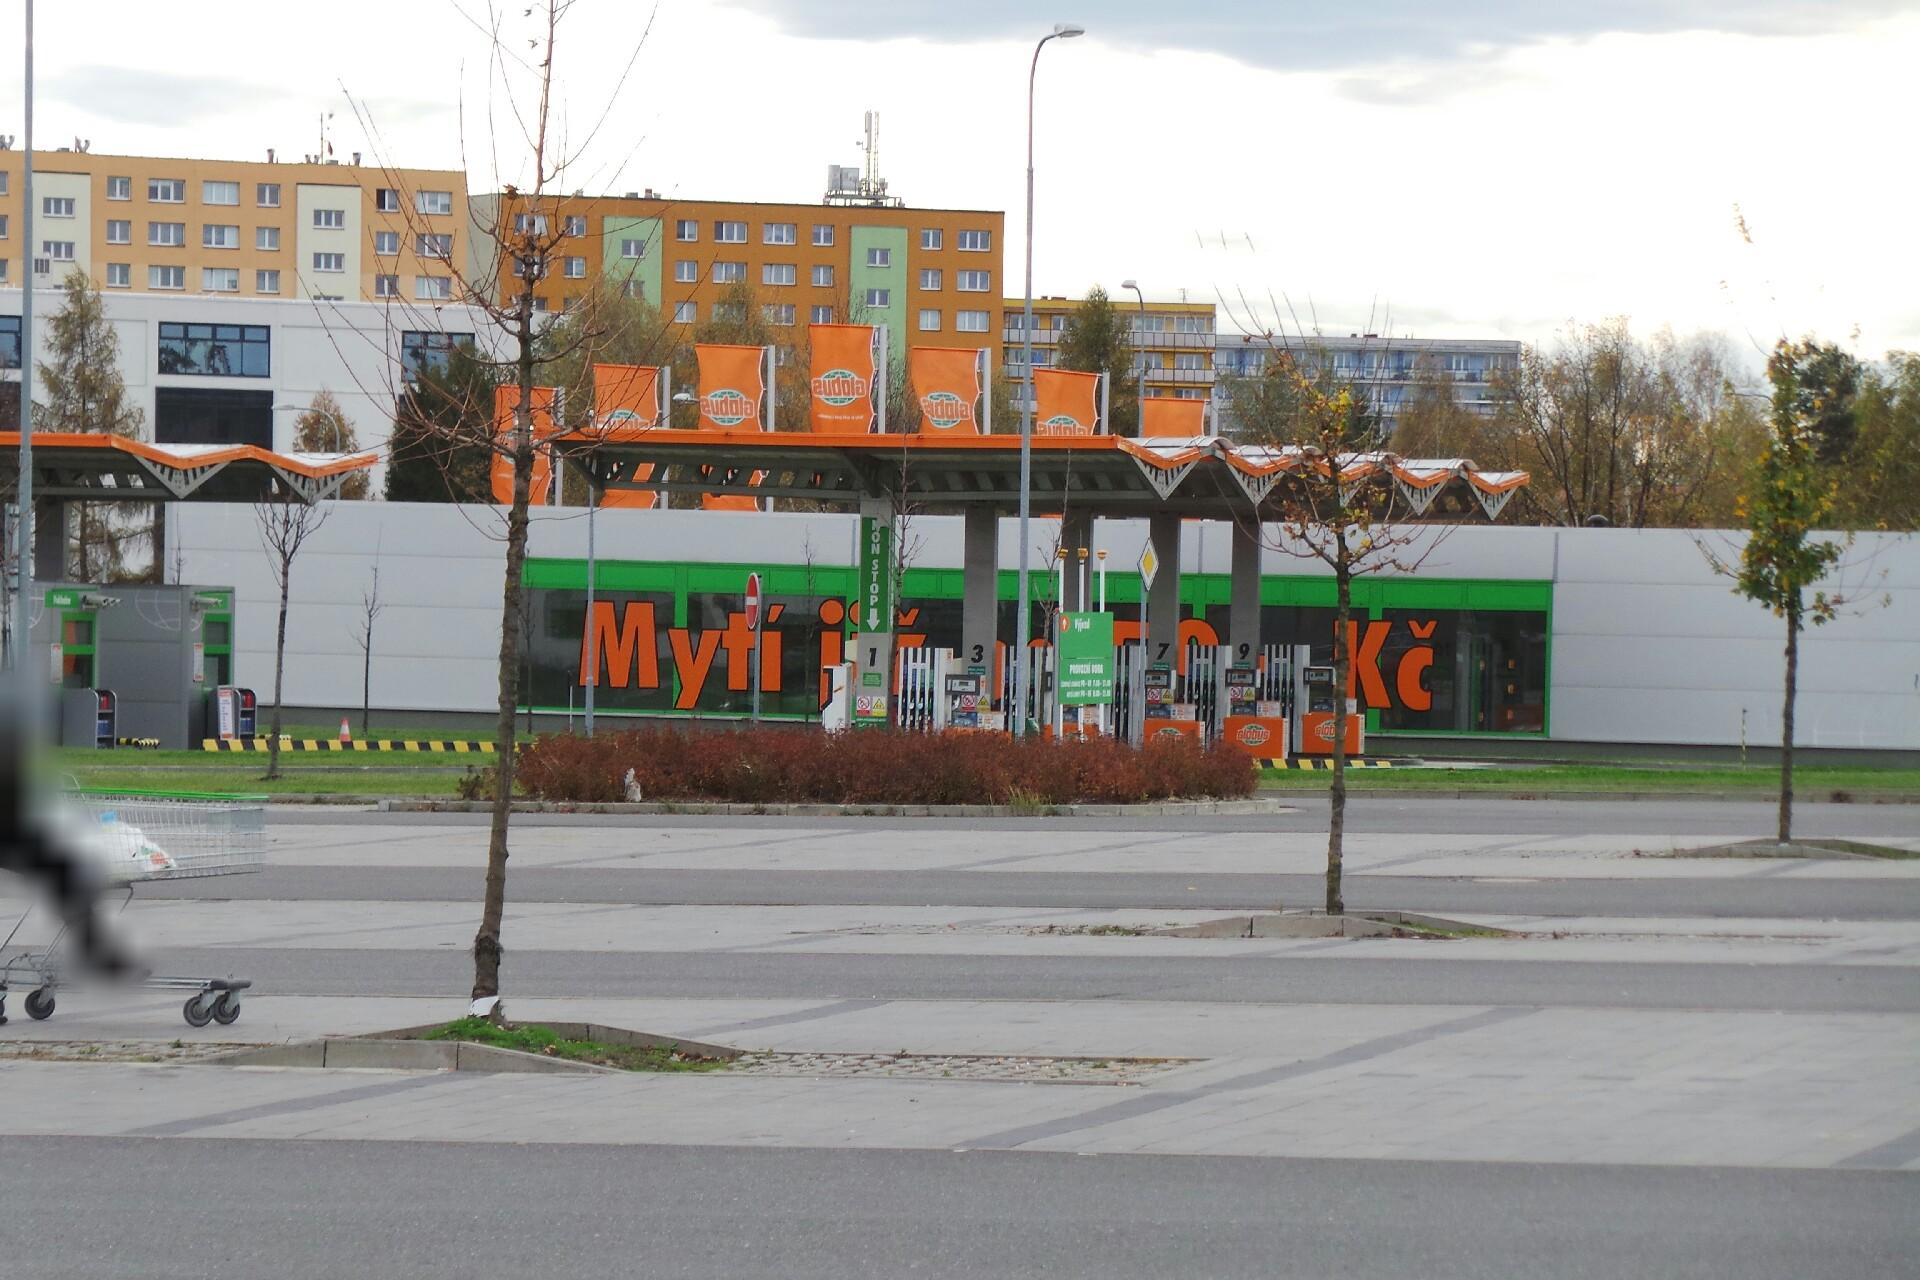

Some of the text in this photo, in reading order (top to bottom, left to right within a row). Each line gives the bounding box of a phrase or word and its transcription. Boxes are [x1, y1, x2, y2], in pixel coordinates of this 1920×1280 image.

[869, 559, 879, 607] STOP
[579, 600, 786, 710] Mytí
[869, 647, 877, 667] 1
[971, 644, 984, 663] 3
[1157, 643, 1170, 660] 7
[1239, 643, 1250, 660] 9
[1334, 619, 1437, 712] Kč
